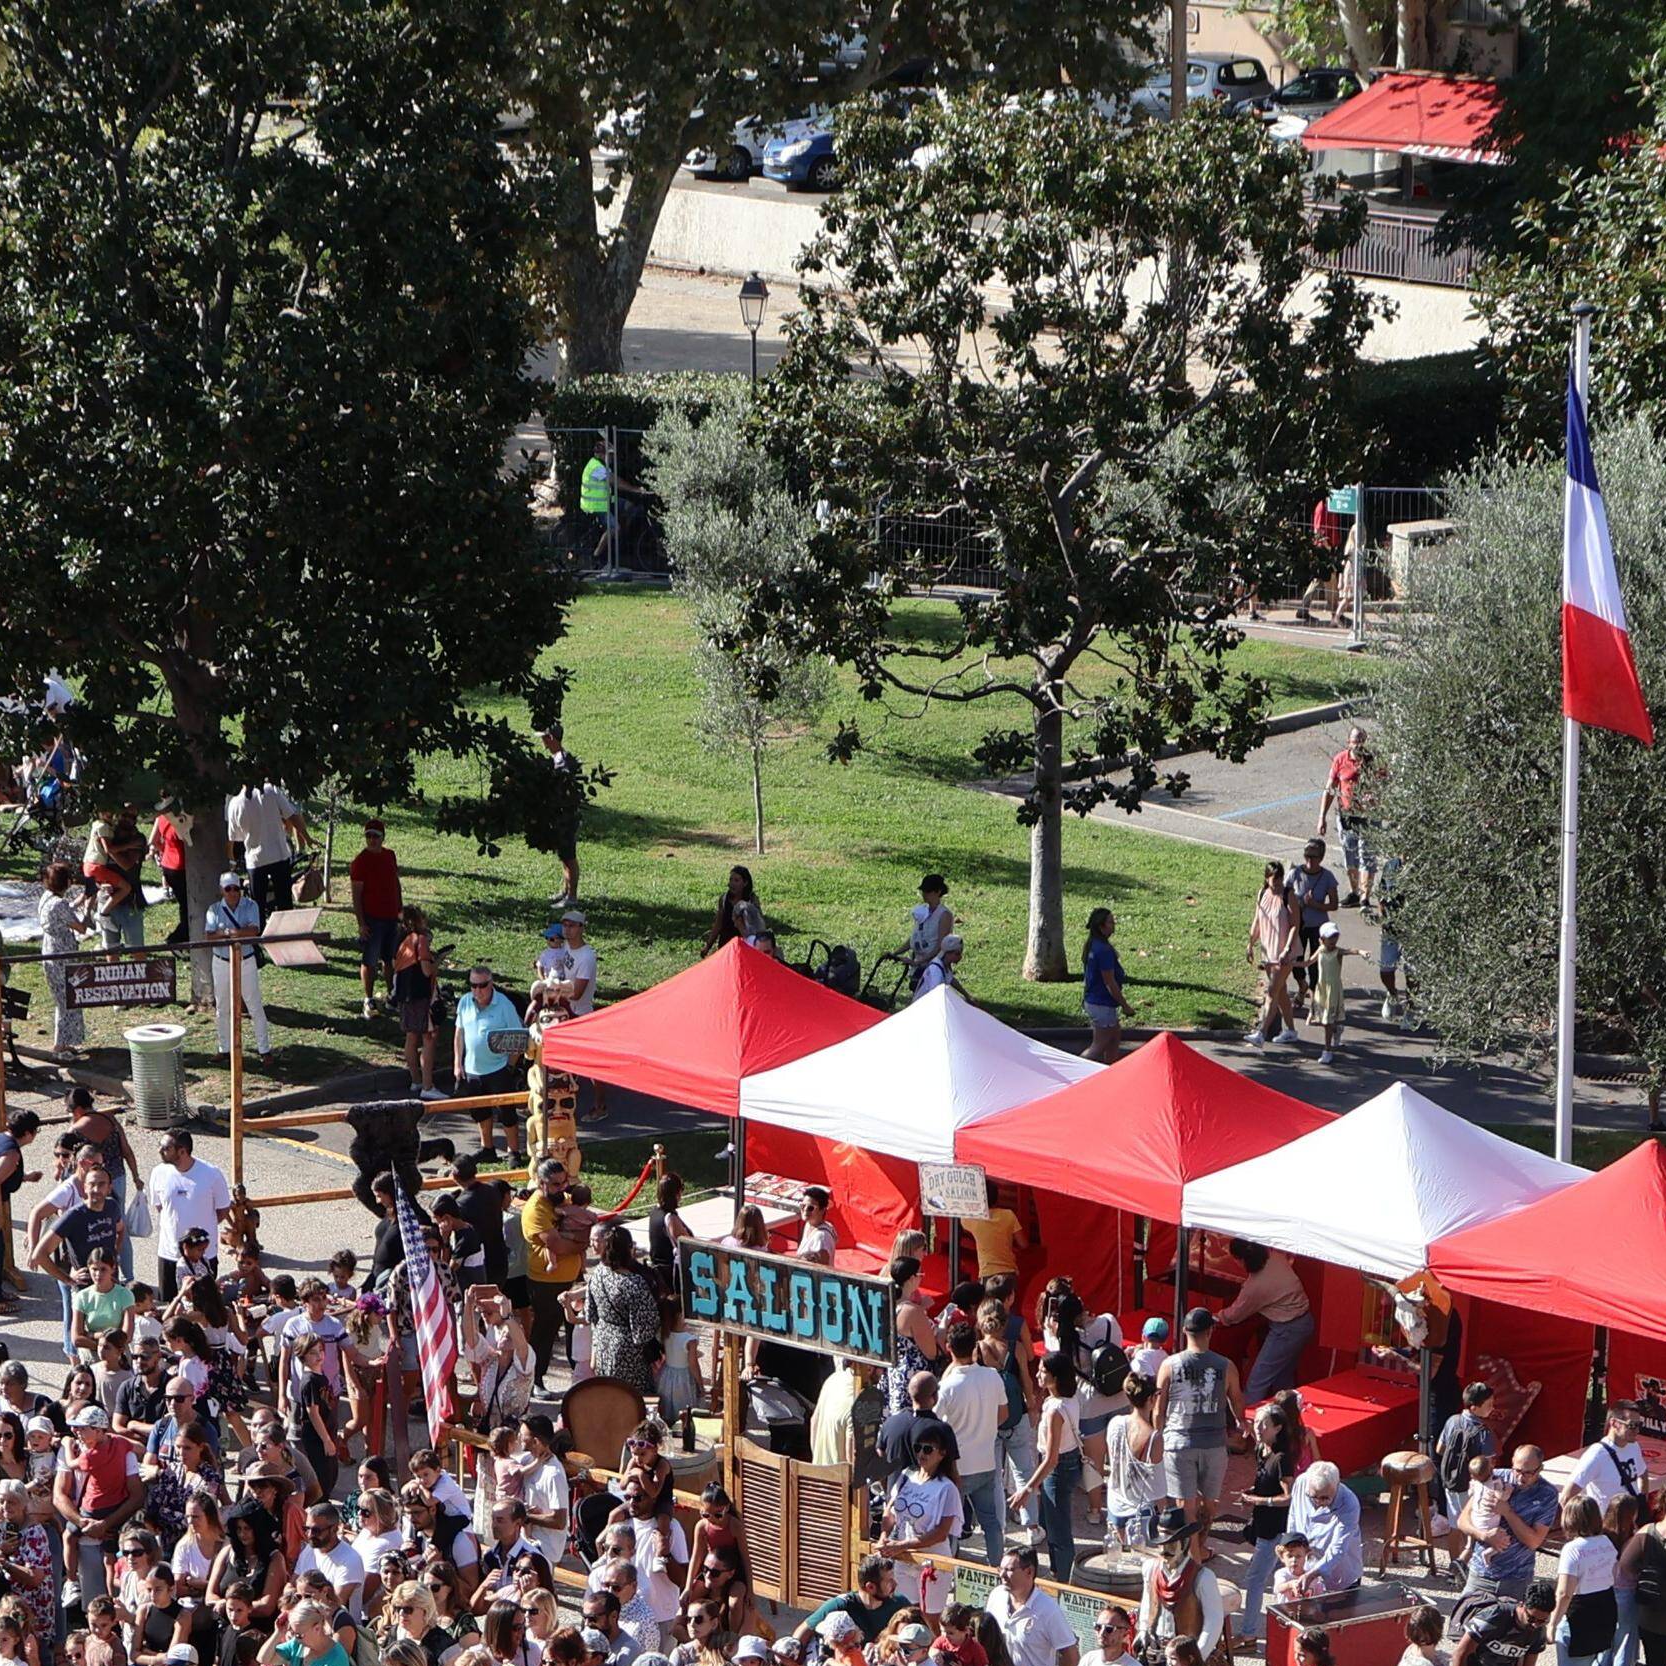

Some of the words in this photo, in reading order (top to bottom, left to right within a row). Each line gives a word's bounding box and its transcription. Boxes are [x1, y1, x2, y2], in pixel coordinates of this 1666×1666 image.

[94, 963, 147, 983] INDIAN
[74, 982, 171, 1004] RESERVATION
[928, 1172, 945, 1190] DRY
[947, 1170, 977, 1187] GULCH
[689, 1251, 883, 1355] SALOON
[957, 1566, 1003, 1588] WANTED
